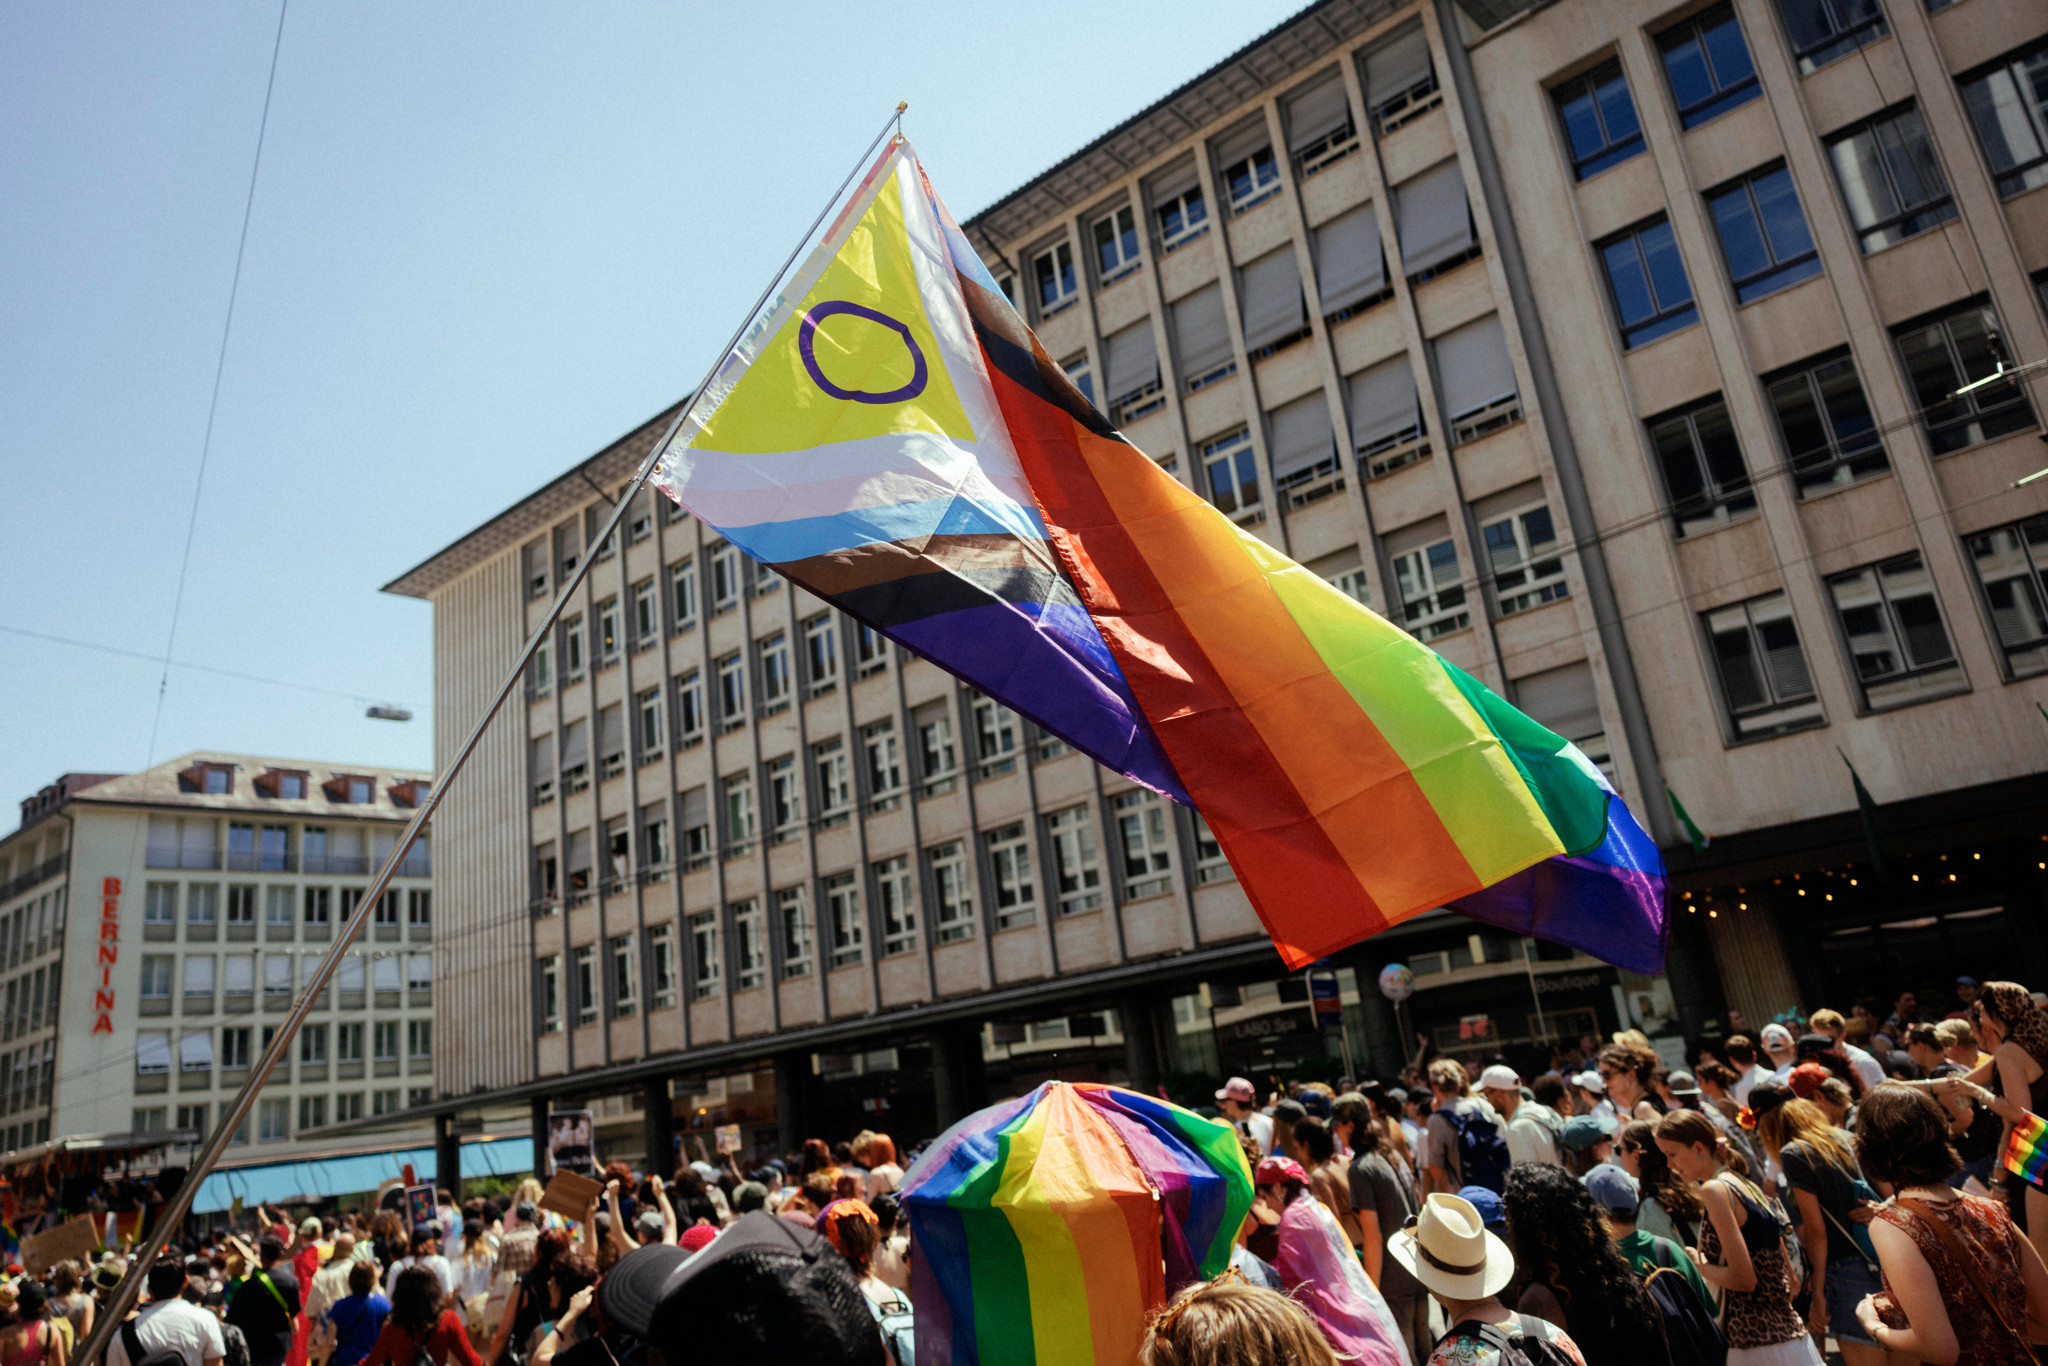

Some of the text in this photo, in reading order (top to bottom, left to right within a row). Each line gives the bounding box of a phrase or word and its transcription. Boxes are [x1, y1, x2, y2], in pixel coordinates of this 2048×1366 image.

[92, 876, 121, 1035] BERNINA
[1535, 973, 1600, 993] Boutique
[1234, 1016, 1297, 1039] LABO Spa
